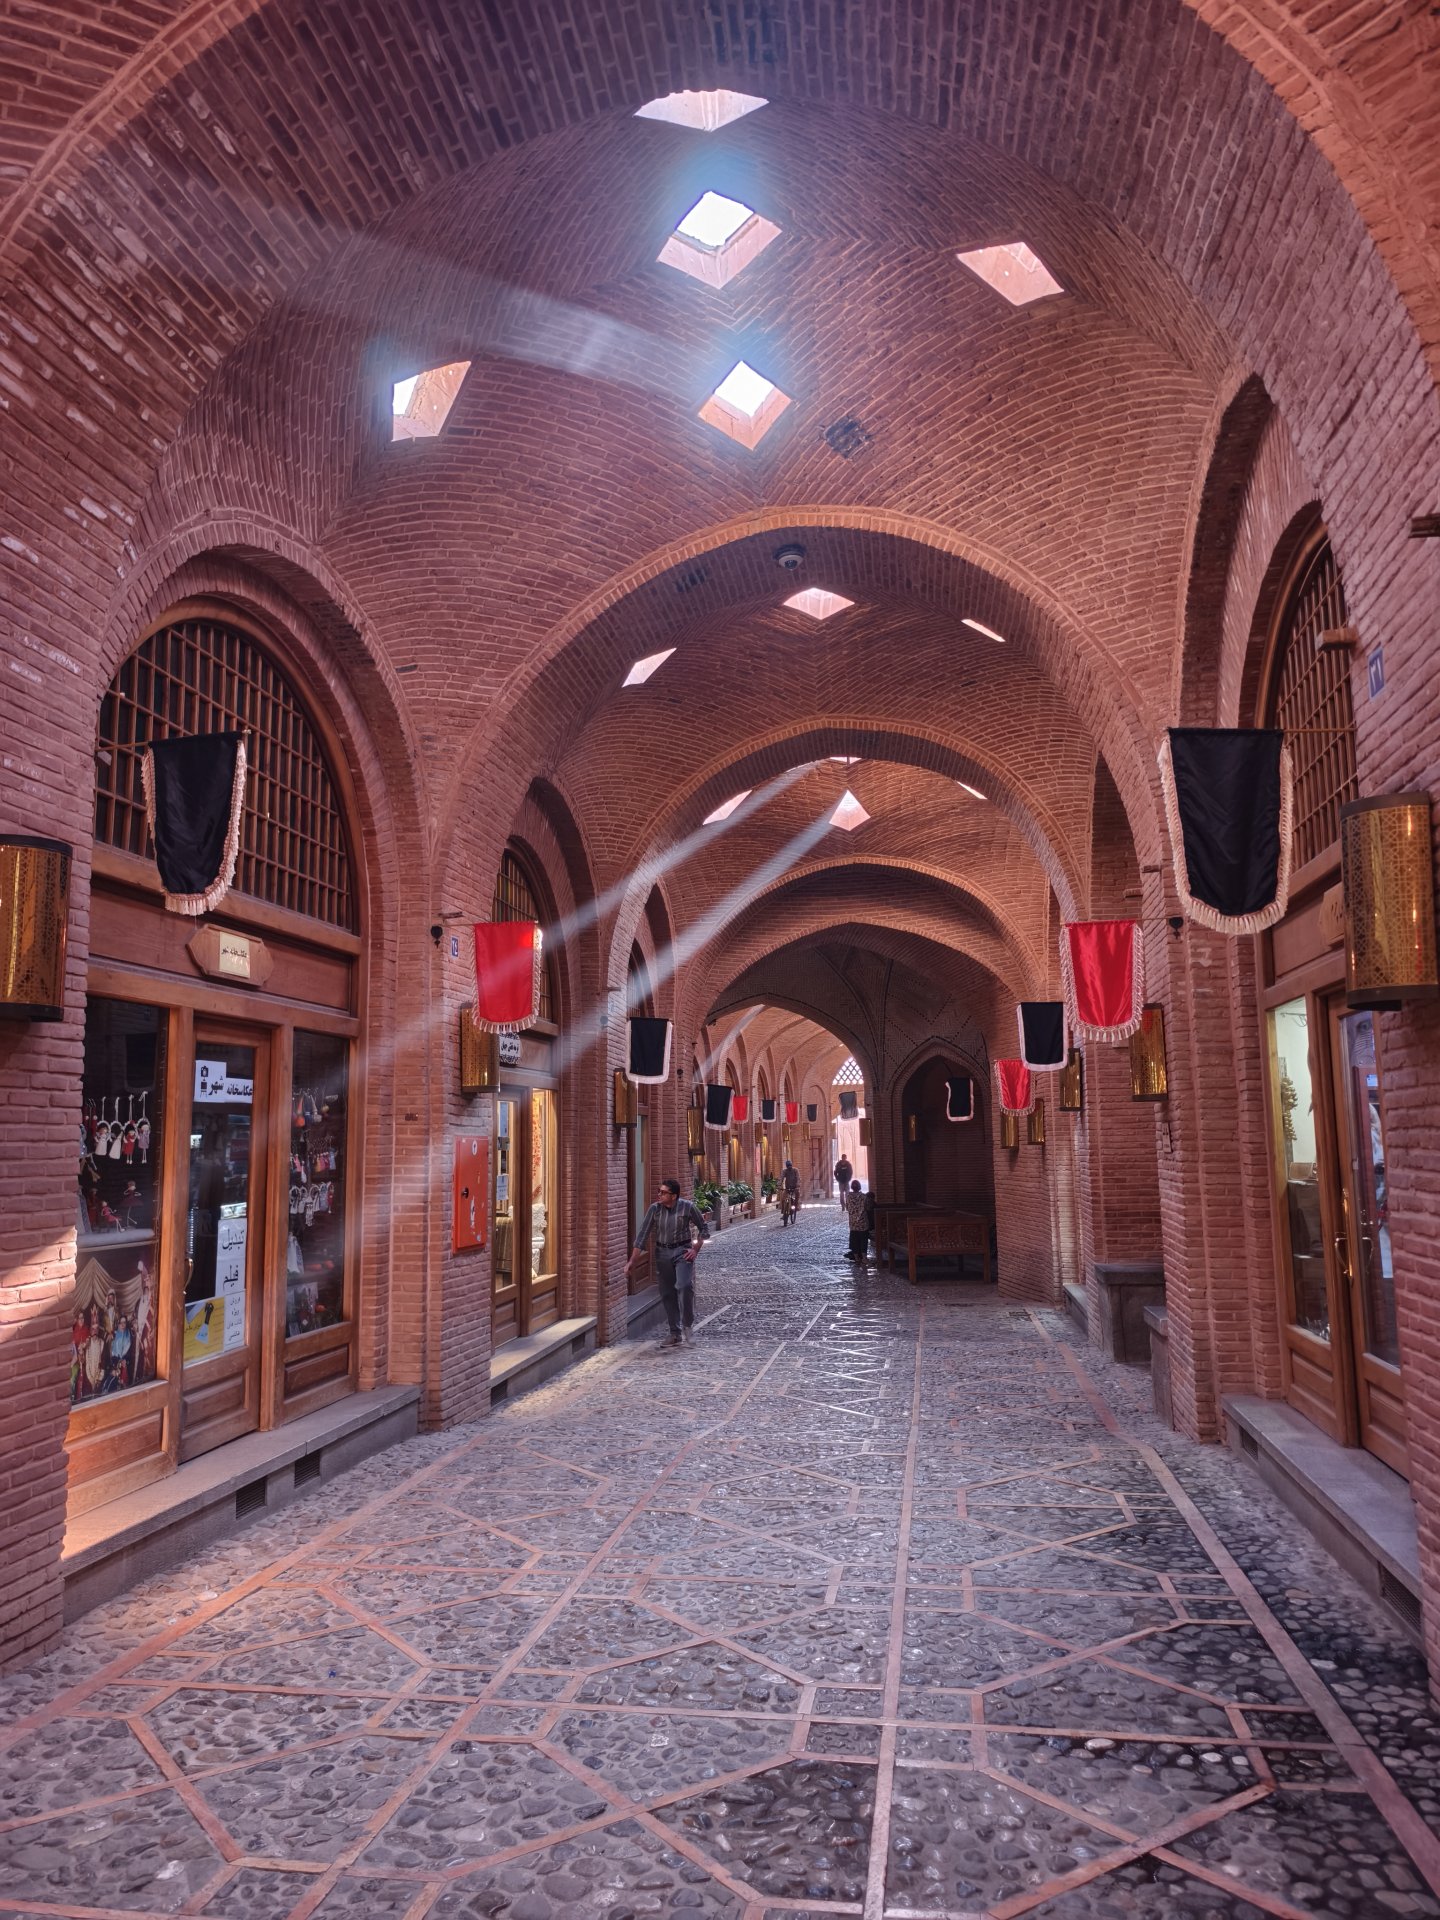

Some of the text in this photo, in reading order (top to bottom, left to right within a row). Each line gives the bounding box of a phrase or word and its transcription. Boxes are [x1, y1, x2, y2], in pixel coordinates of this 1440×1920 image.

[208, 1075, 253, 1097] عکاسخانه شهر
[221, 1228, 245, 1251] تبدیل
[222, 1264, 239, 1292] فیلم
